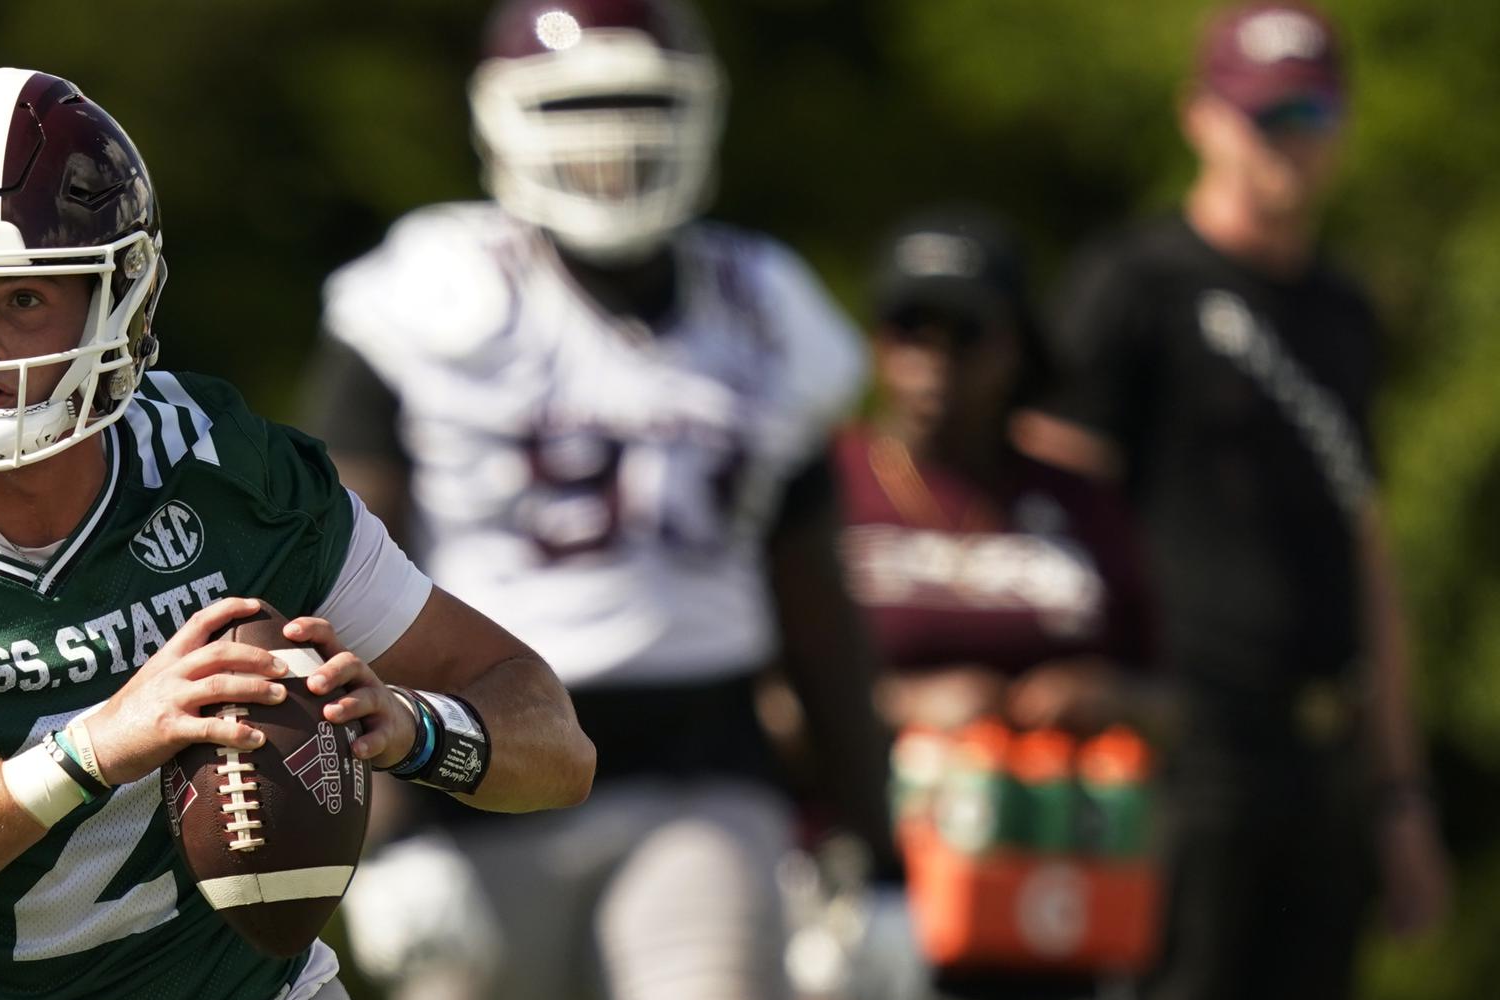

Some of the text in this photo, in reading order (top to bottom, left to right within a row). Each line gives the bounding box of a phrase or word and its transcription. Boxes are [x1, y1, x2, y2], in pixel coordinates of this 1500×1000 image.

[133, 504, 198, 567] SEC
[82, 746, 100, 778] HUMB
[318, 720, 342, 814] adidas
[12, 700, 180, 962] 2
